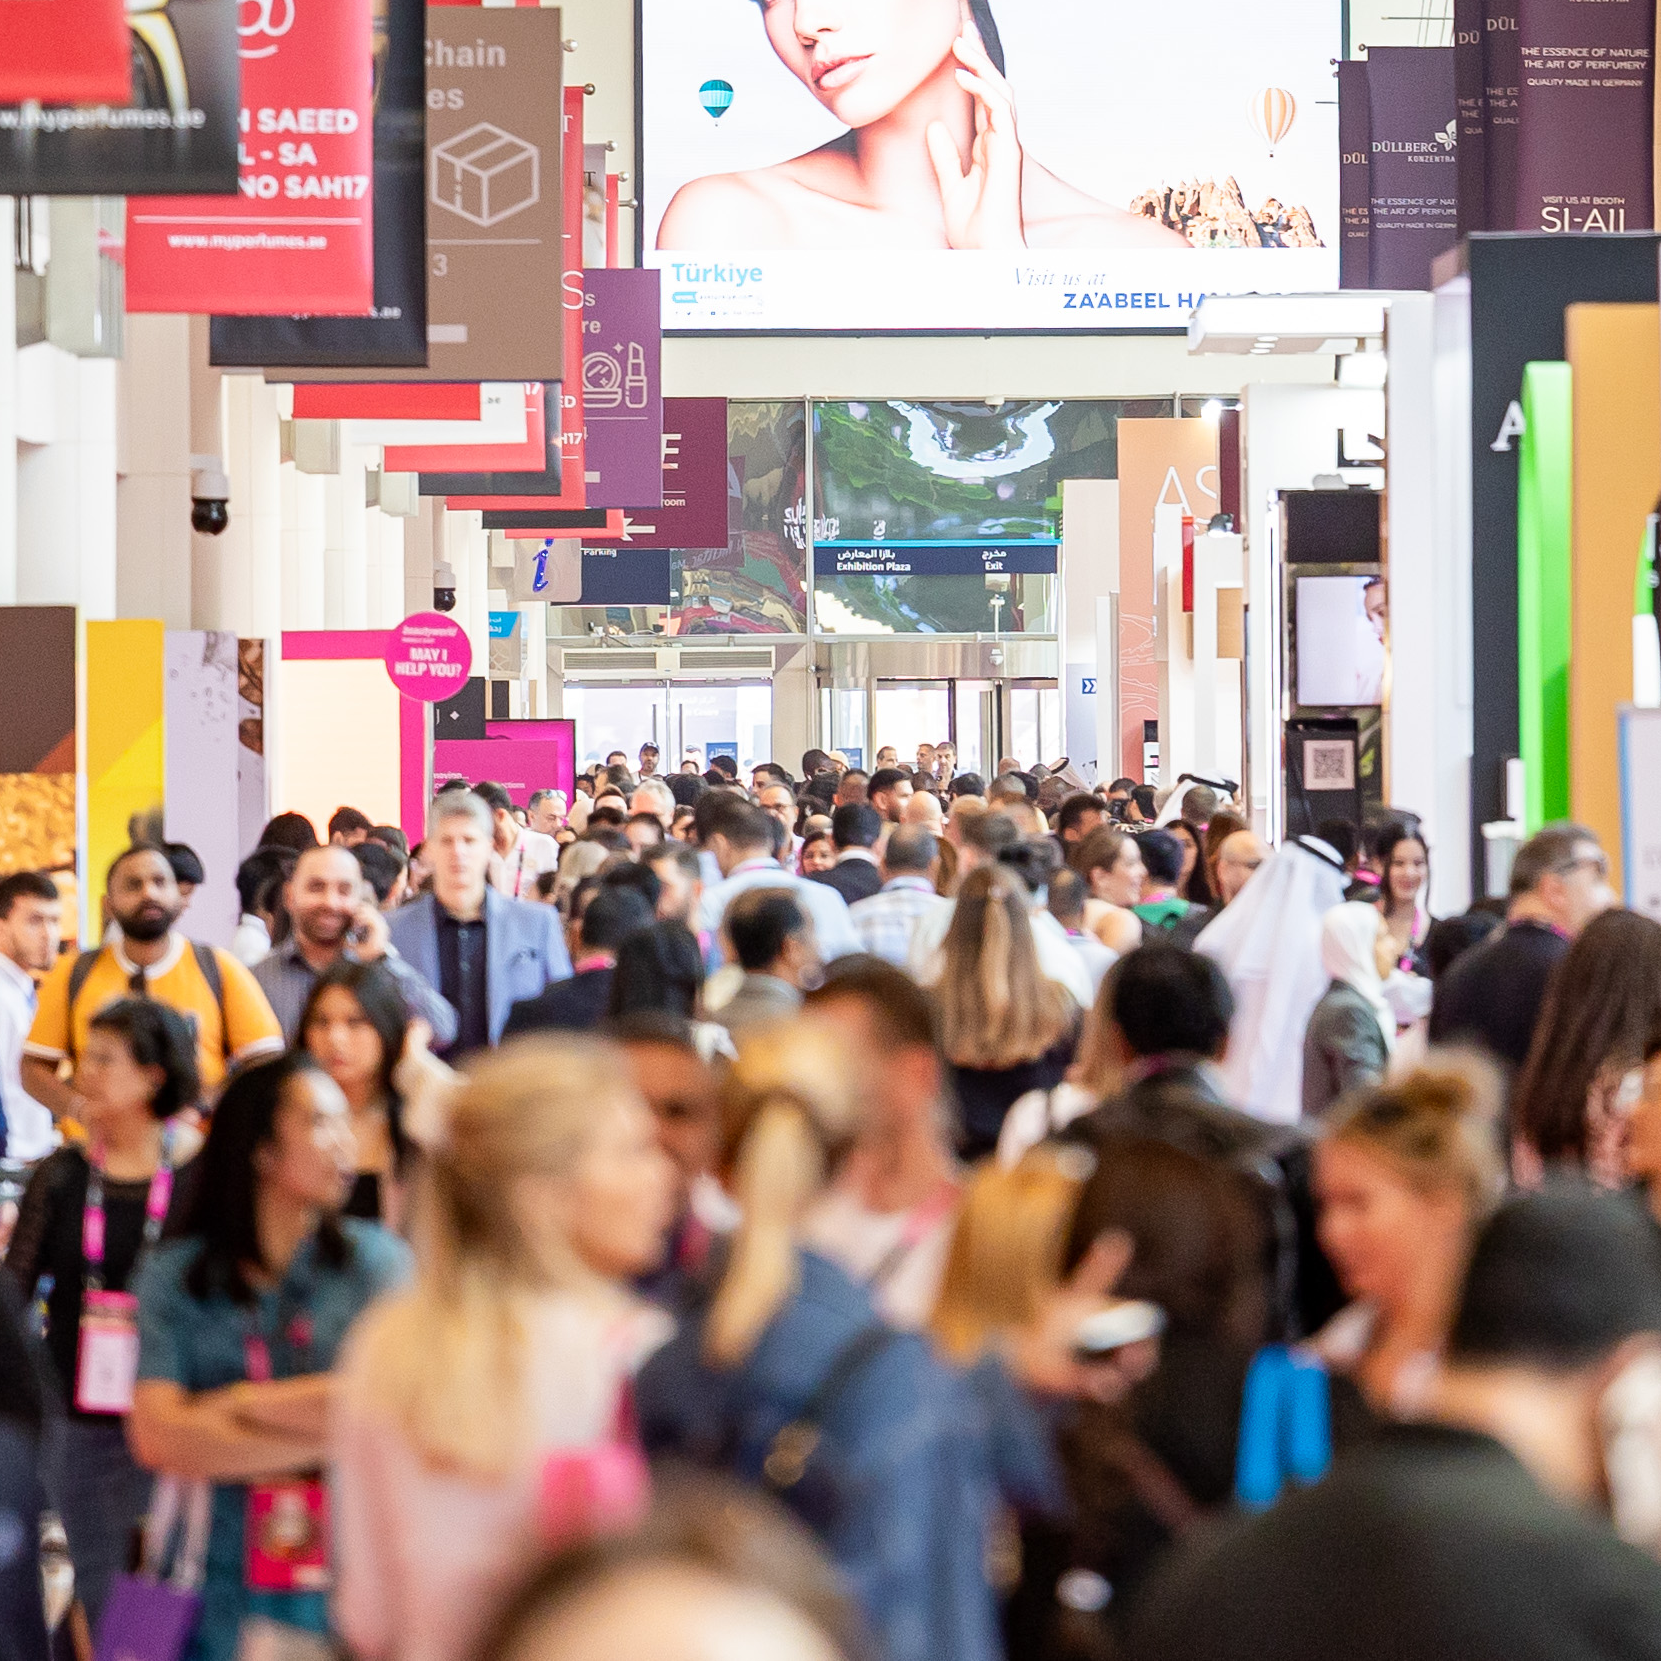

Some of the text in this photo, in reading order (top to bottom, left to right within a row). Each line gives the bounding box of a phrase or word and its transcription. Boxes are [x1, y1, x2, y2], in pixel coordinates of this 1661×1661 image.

[1521, 47, 1540, 56] THE
[1542, 48, 1589, 57] ESSENCE
[1592, 48, 1607, 57] OF
[1524, 59, 1544, 69] THE
[1546, 60, 1565, 68] ART
[1568, 60, 1583, 69] OF
[1527, 77, 1563, 86] QUALITY
[1565, 78, 1589, 86] MADE
[257, 108, 360, 134] SAEED
[1372, 140, 1438, 153] DÜLLBERG
[277, 142, 317, 166] SA
[1407, 155, 1456, 163] KONZENTRA
[284, 174, 370, 201] SAH17
[1542, 196, 1626, 205] VISIT US AT BOOTH
[166, 232, 328, 250] www.myperfumes.ae
[671, 263, 763, 287] Türkiye
[1015, 267, 1106, 286] Visit us at
[837, 561, 911, 572] Exhibition Plaza
[985, 562, 1003, 571] Exit
[409, 647, 440, 662] MAY
[394, 661, 463, 678] HELP YOU?
